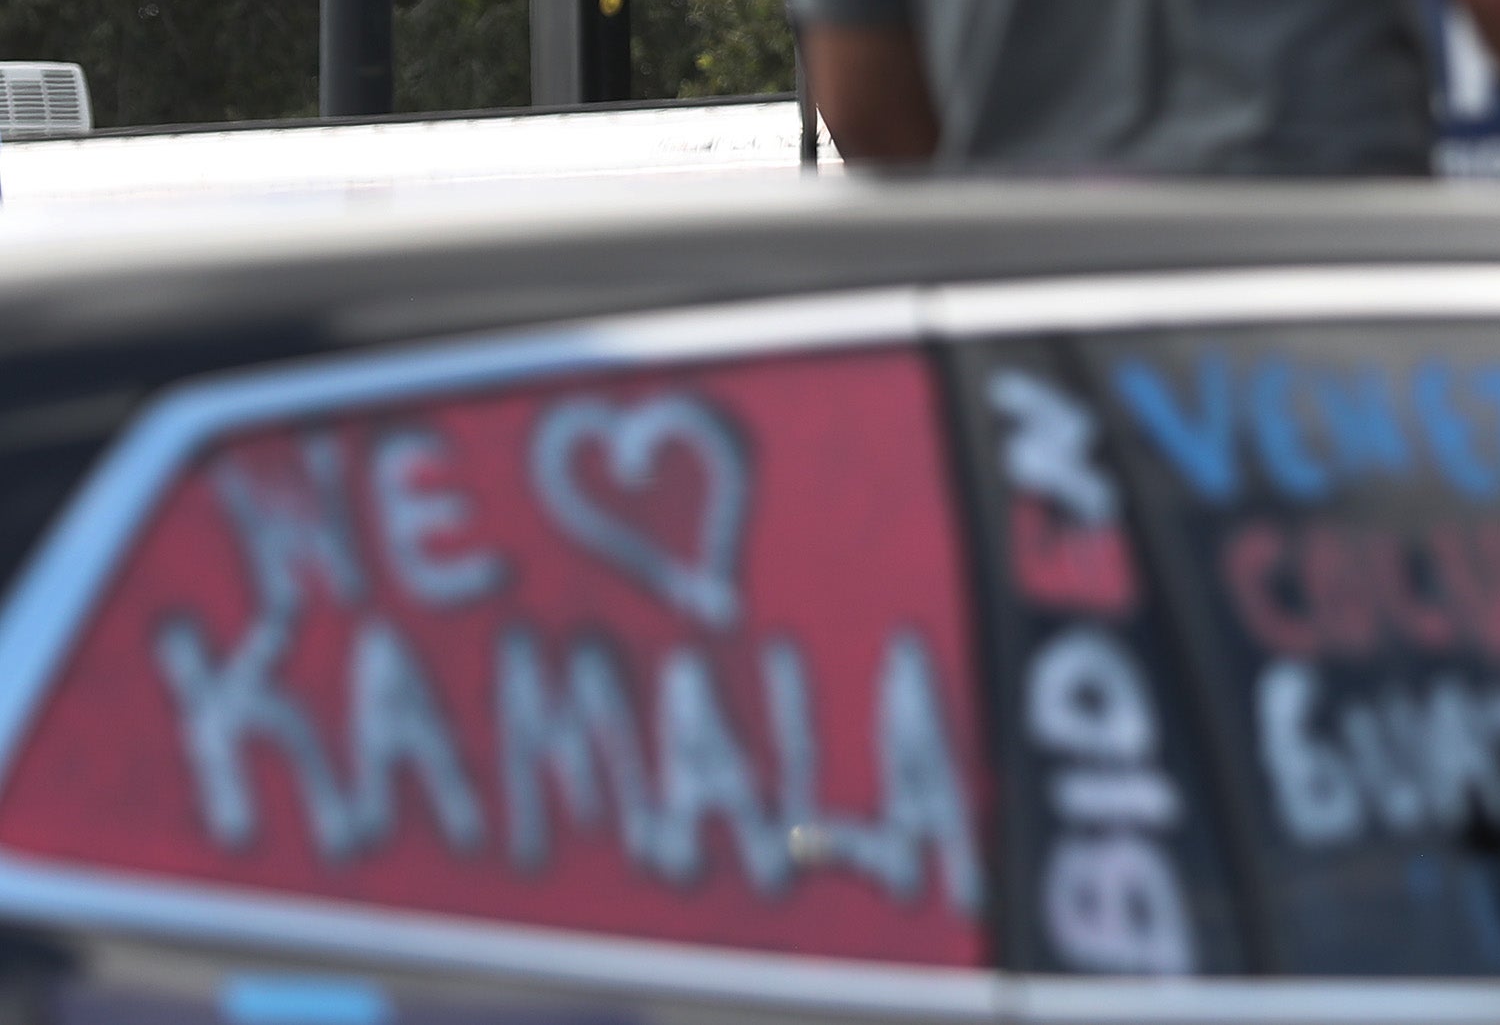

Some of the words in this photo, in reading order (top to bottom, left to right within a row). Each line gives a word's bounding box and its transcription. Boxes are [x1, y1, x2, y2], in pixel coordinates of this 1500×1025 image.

[205, 420, 512, 607] WE
[150, 615, 985, 920] KAMALA
[990, 368, 1192, 979] BIDEN
